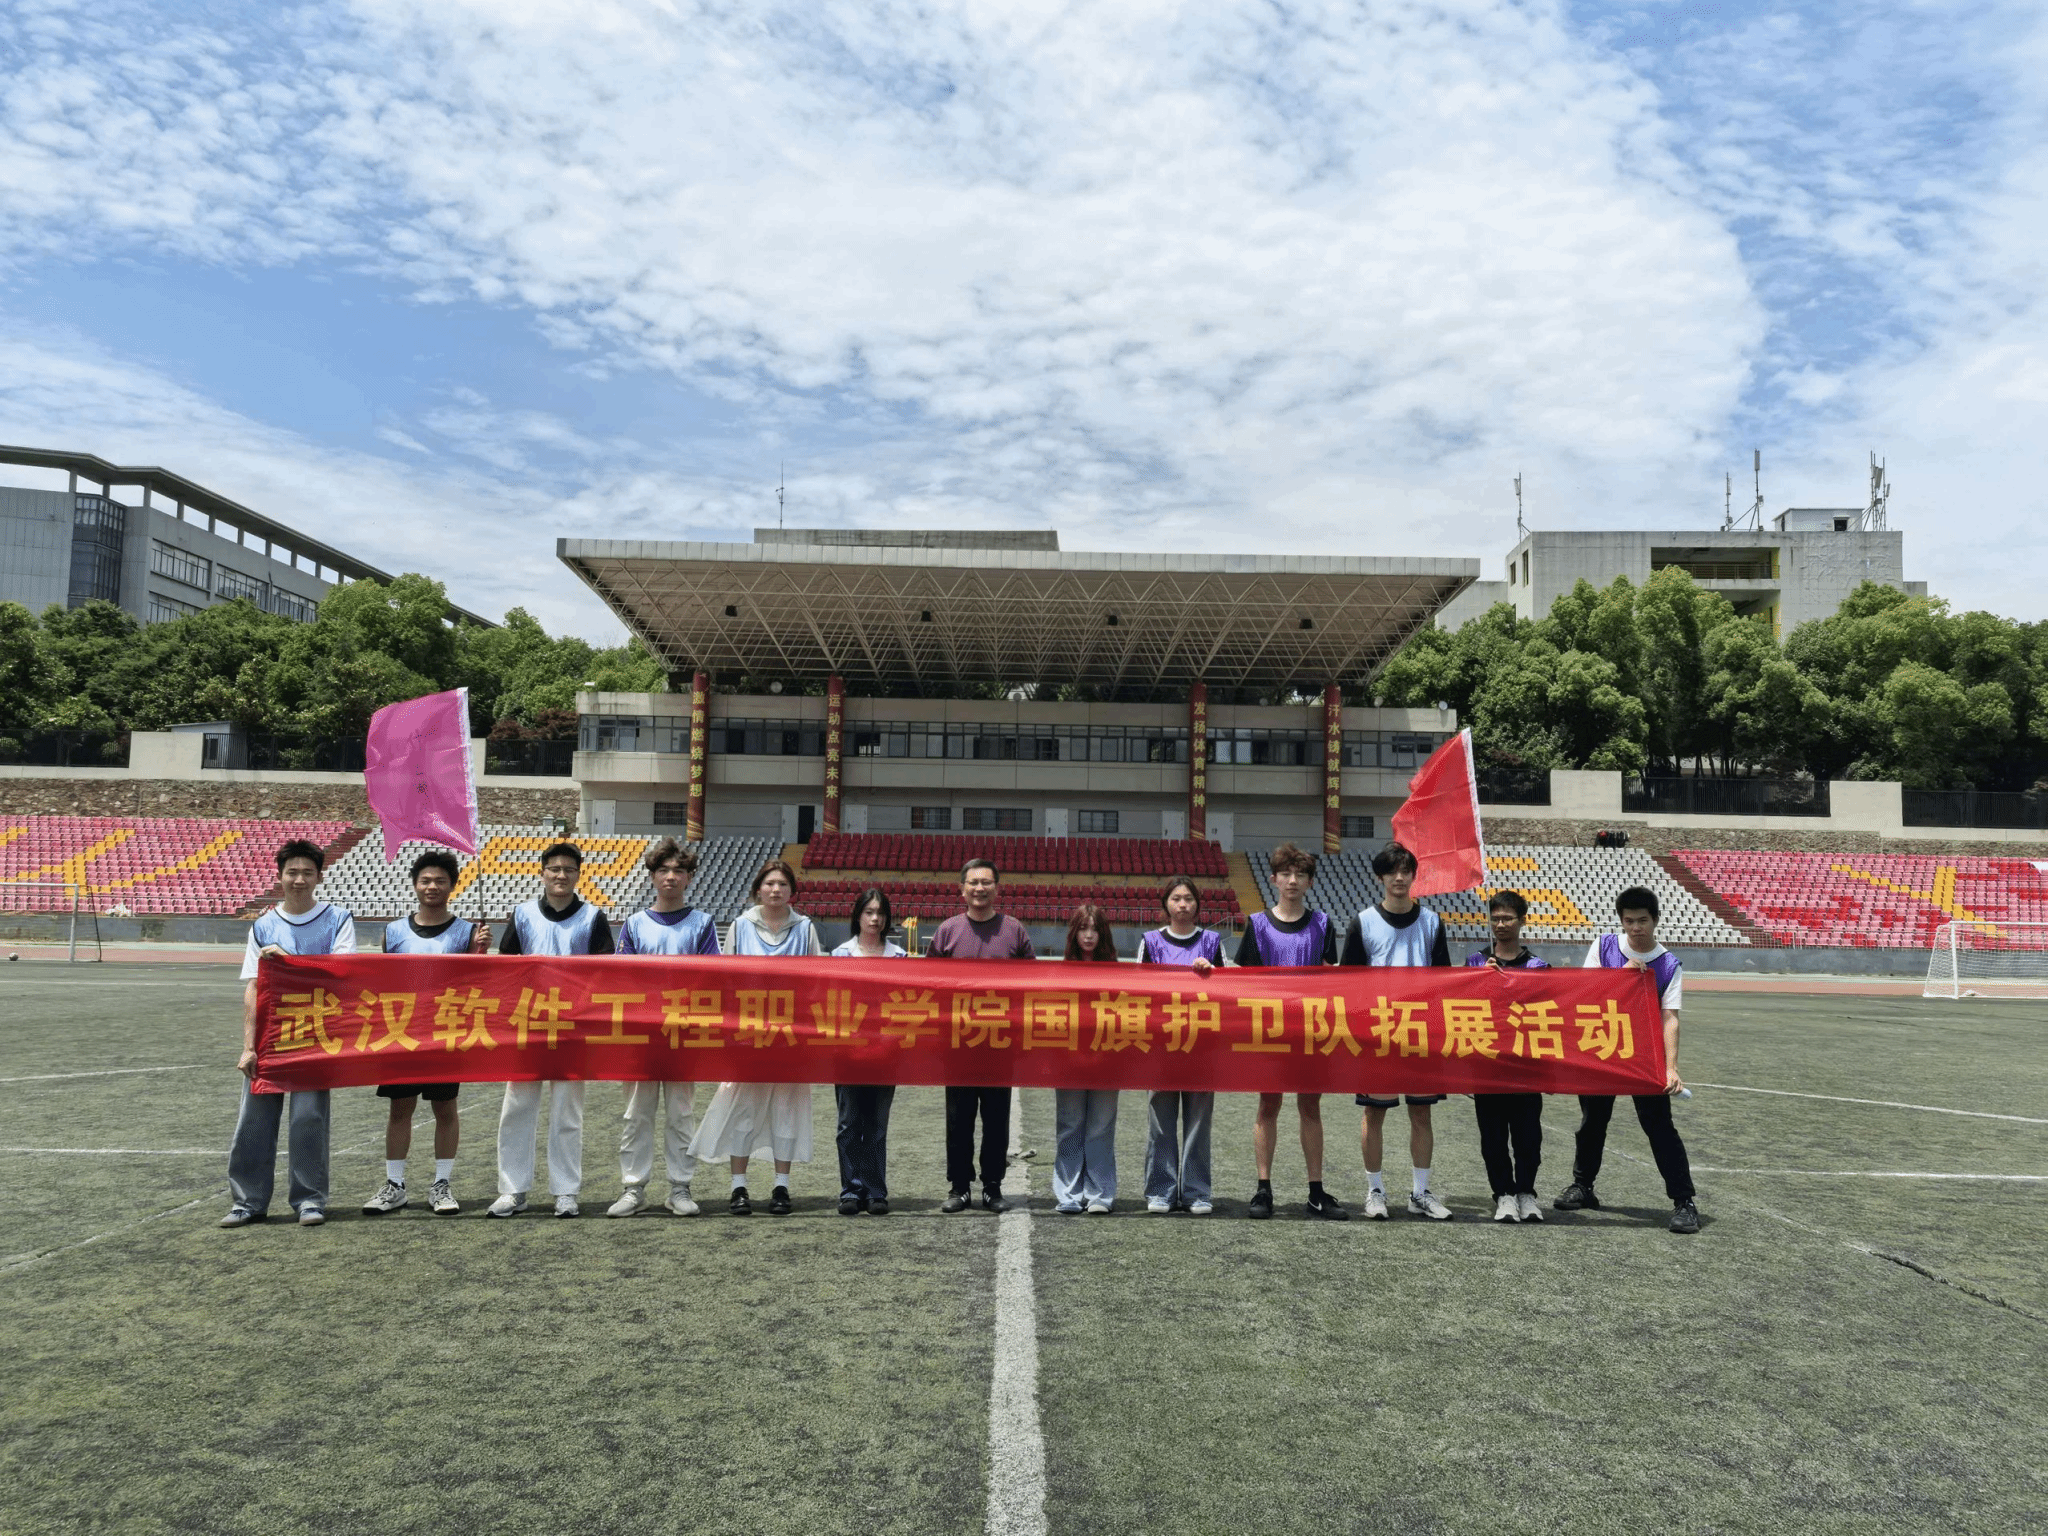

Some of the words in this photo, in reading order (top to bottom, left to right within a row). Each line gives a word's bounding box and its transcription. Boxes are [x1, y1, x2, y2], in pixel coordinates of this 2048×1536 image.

[688, 691, 705, 798] 激情燃烧梦想
[826, 694, 841, 799] 运动点亮未来
[1192, 702, 1206, 808] 发扬体育精神
[1326, 704, 1341, 809] 汗水铸就辉煌
[273, 985, 1635, 1060] 武汉软件工程职业学院国旗护卫队拓展活动
